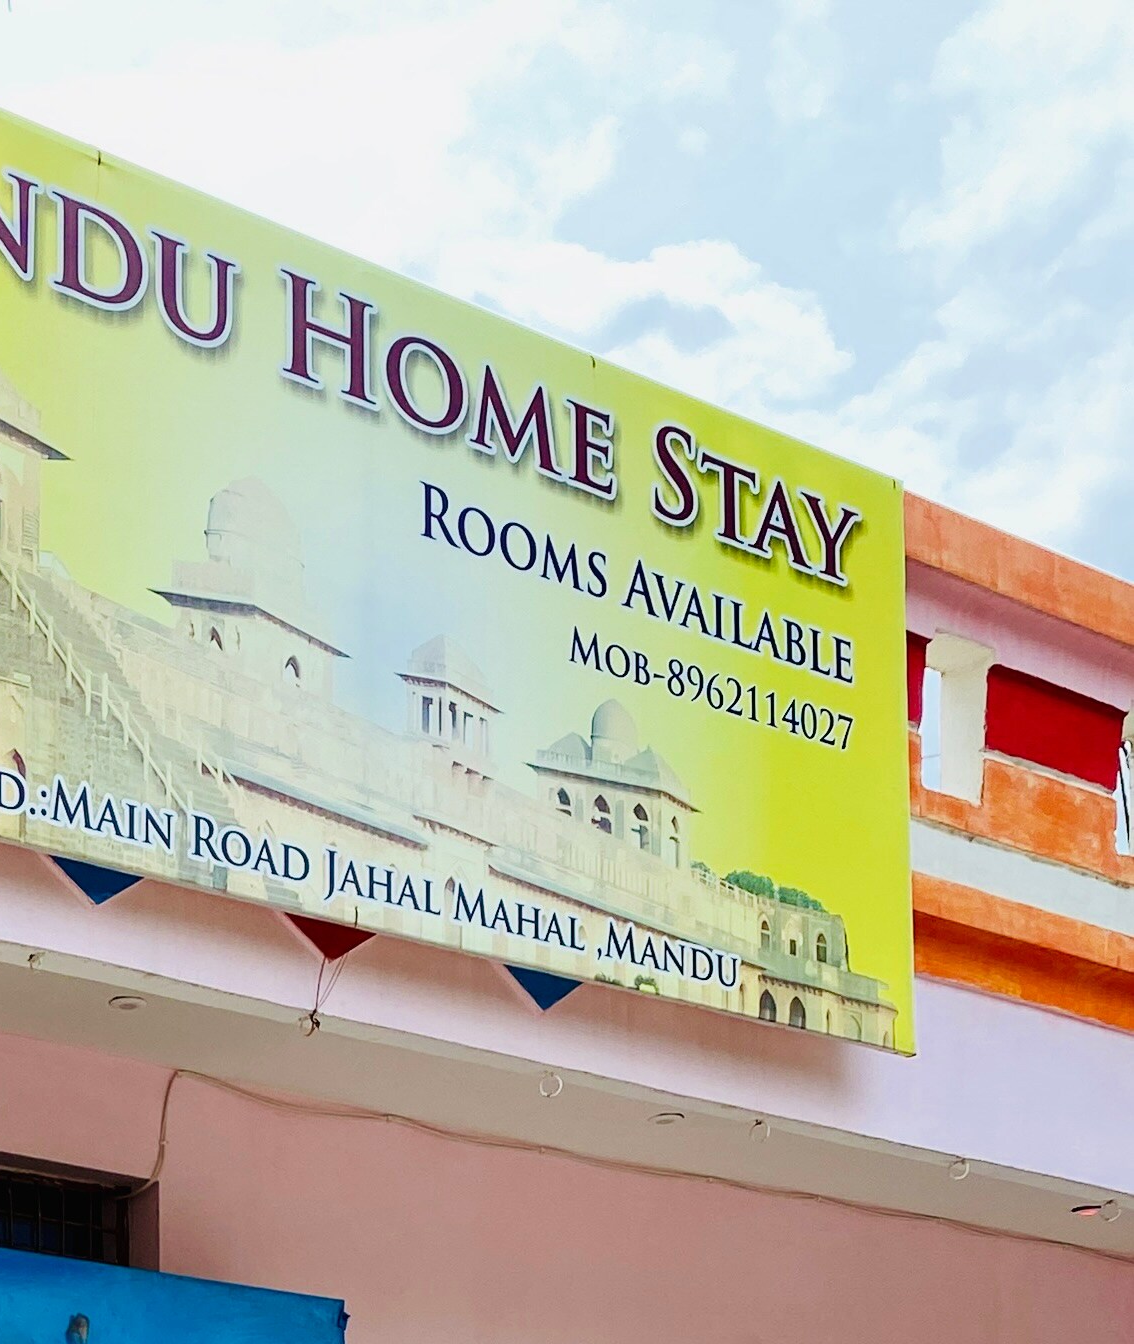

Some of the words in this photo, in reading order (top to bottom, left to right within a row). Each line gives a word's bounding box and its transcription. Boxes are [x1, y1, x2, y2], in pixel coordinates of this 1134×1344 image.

[282, 269, 615, 495] HOME
[653, 426, 860, 583] STAY
[419, 481, 608, 598] ROOMS
[622, 559, 854, 684] AVAILABLE
[570, 627, 854, 750] MOB-8962114027
[192, 814, 310, 881] ROAD
[324, 849, 441, 916] JAHAL
[453, 883, 586, 951] MAHAL
